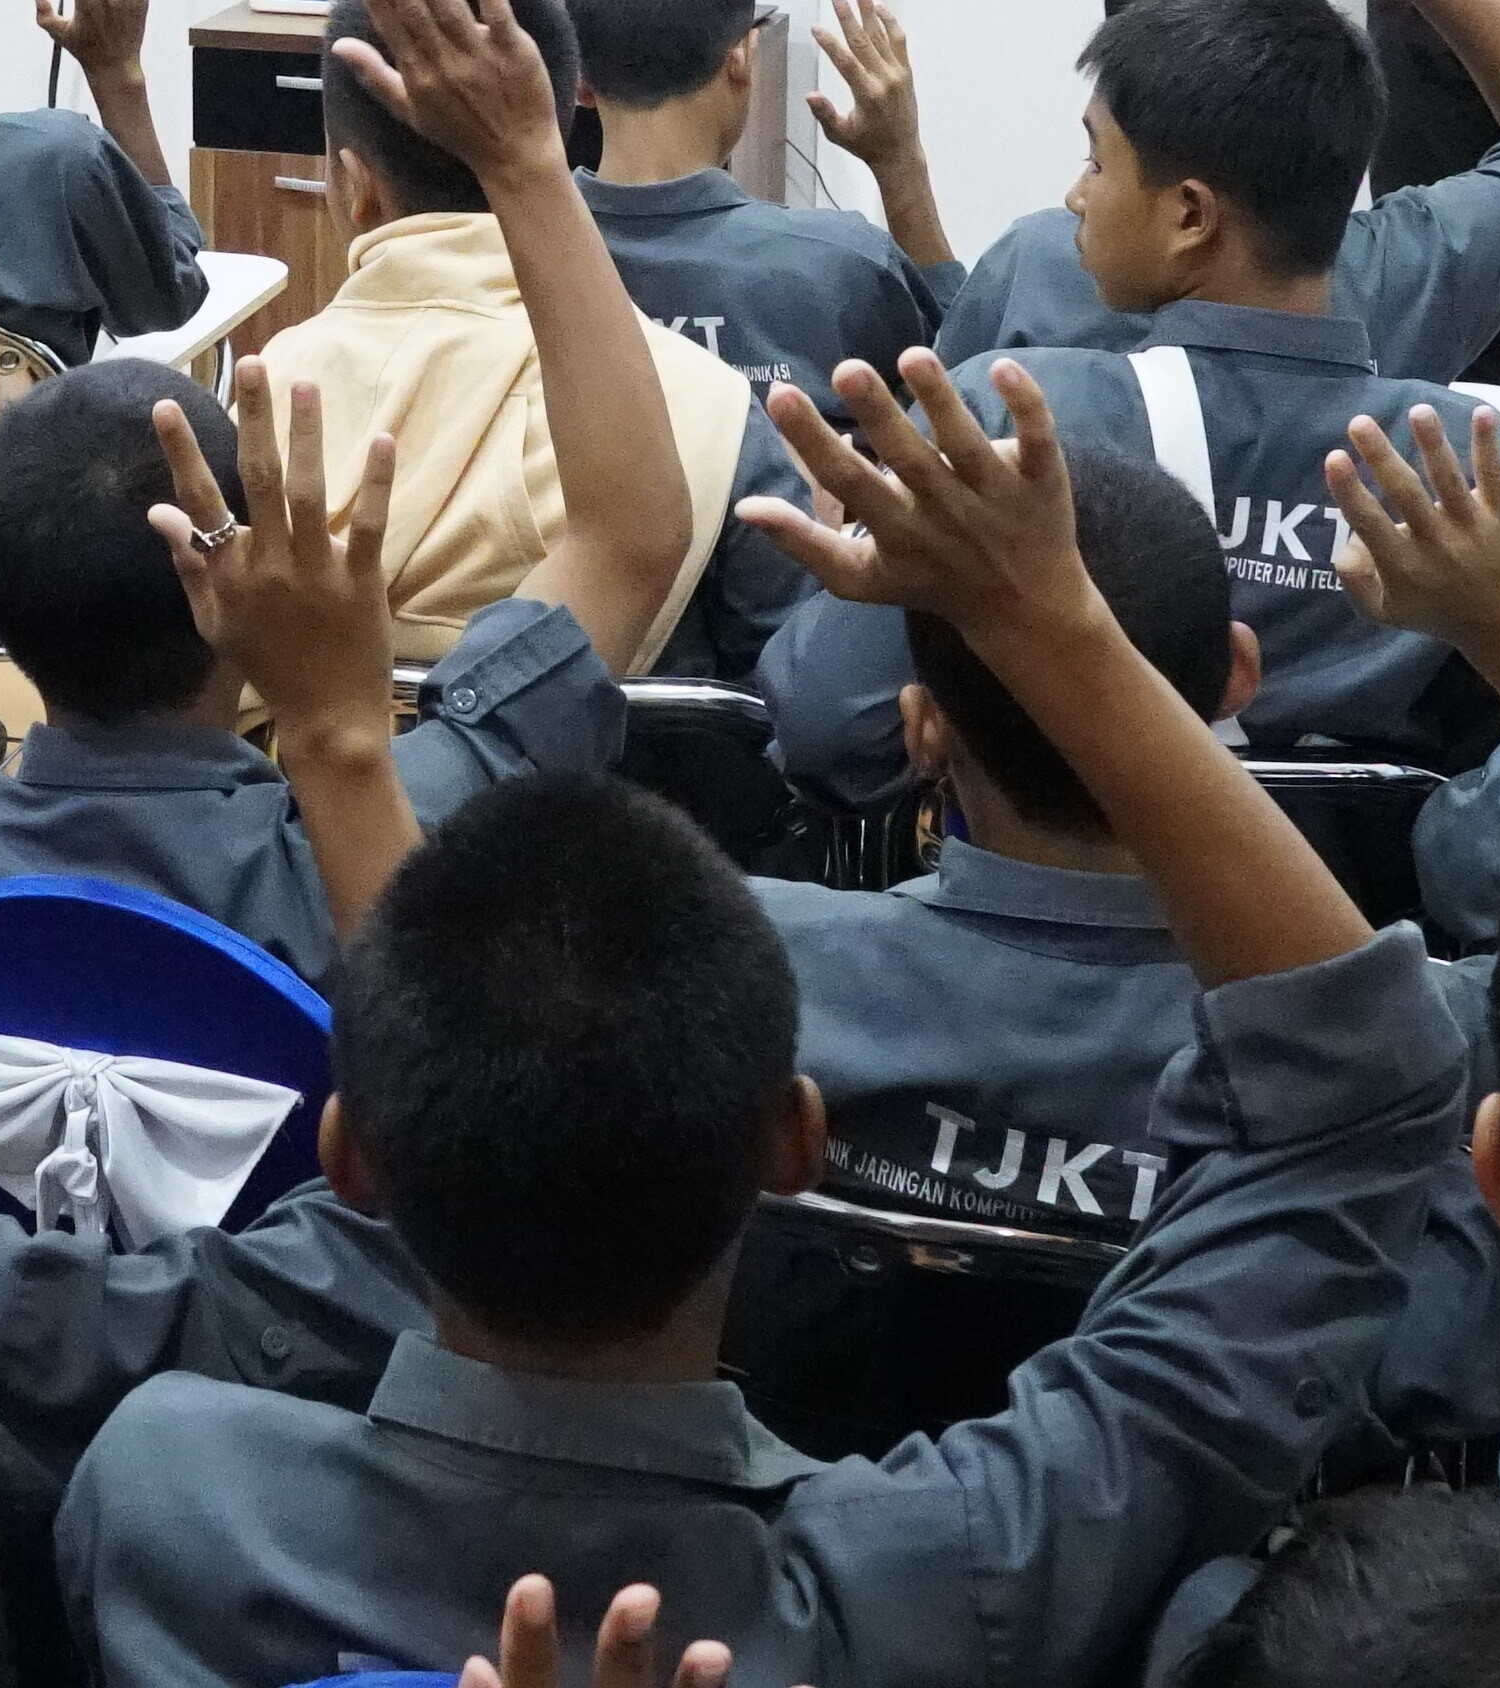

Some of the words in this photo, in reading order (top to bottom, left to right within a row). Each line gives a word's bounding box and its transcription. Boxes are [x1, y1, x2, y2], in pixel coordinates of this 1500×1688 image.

[1224, 556, 1274, 584] PUTER
[1275, 565, 1309, 590] DAN
[823, 1136, 851, 1171] NIK
[854, 1150, 945, 1207] JARINGAN
[925, 1100, 1168, 1222] TJKT
